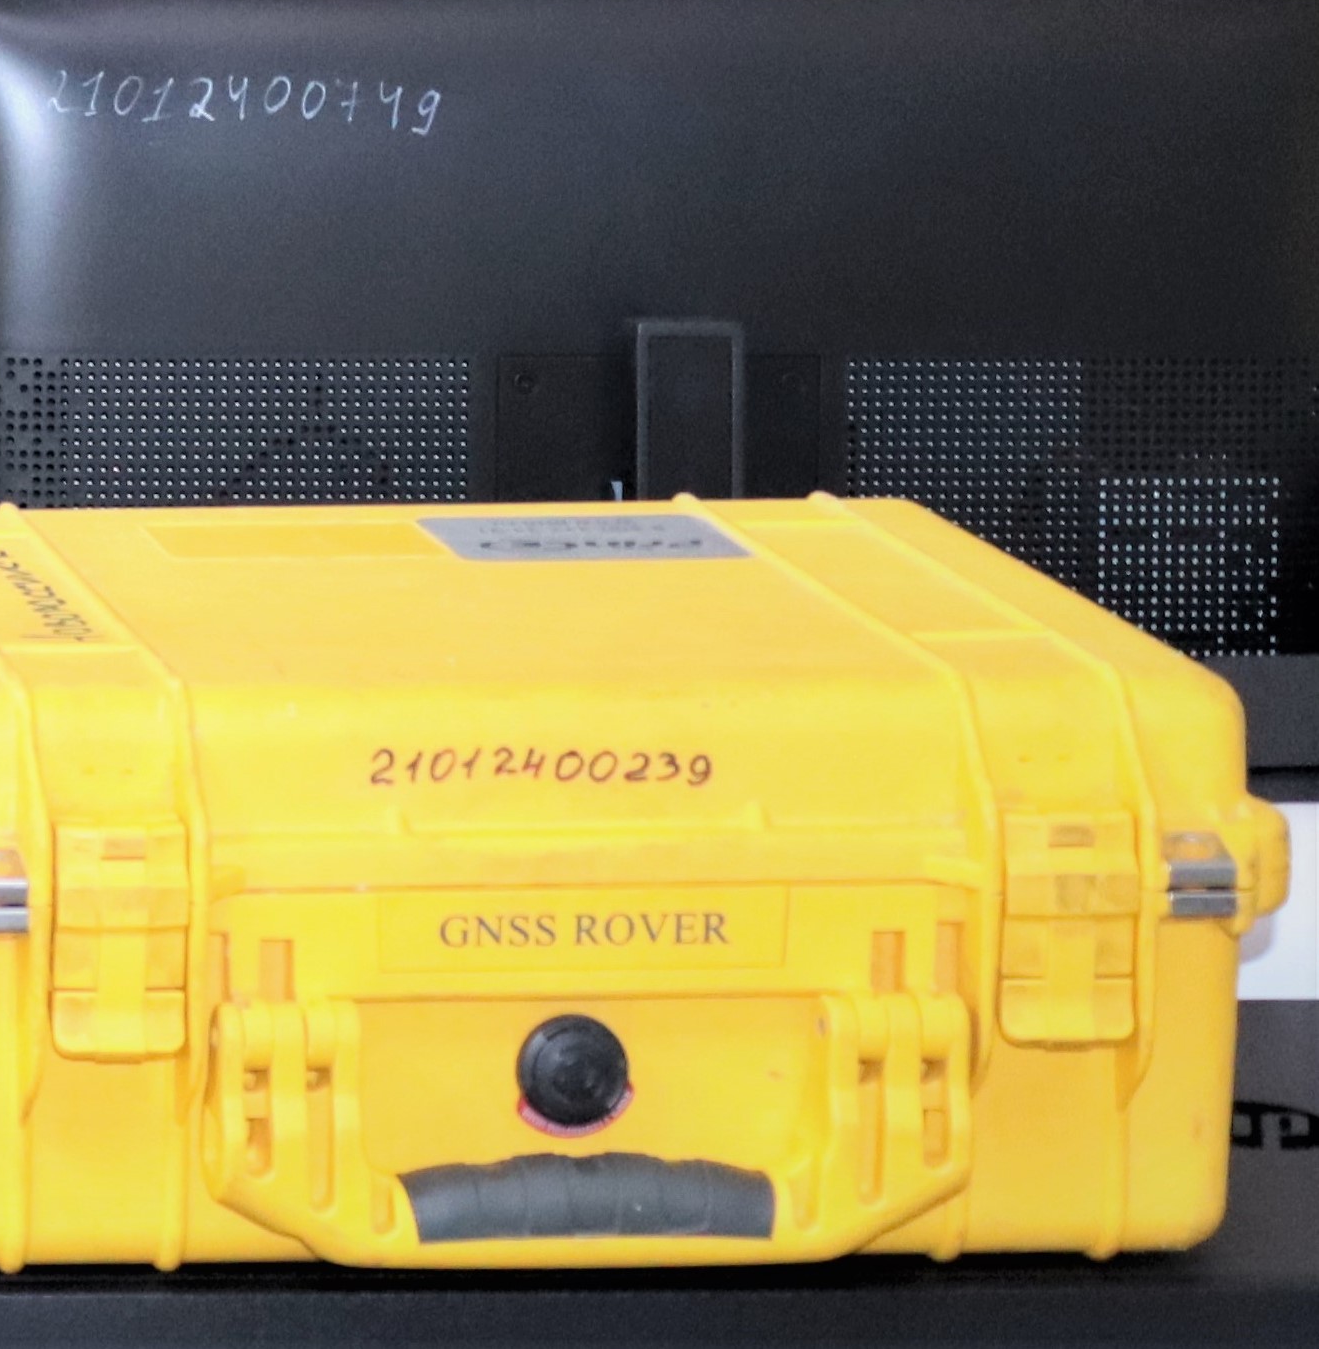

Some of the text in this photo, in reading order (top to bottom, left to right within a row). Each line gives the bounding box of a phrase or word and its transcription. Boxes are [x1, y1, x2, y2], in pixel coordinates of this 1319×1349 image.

[48, 69, 442, 136] 21012400749
[368, 746, 713, 786] 21012400239
[438, 912, 731, 948] GNSS ROVER
